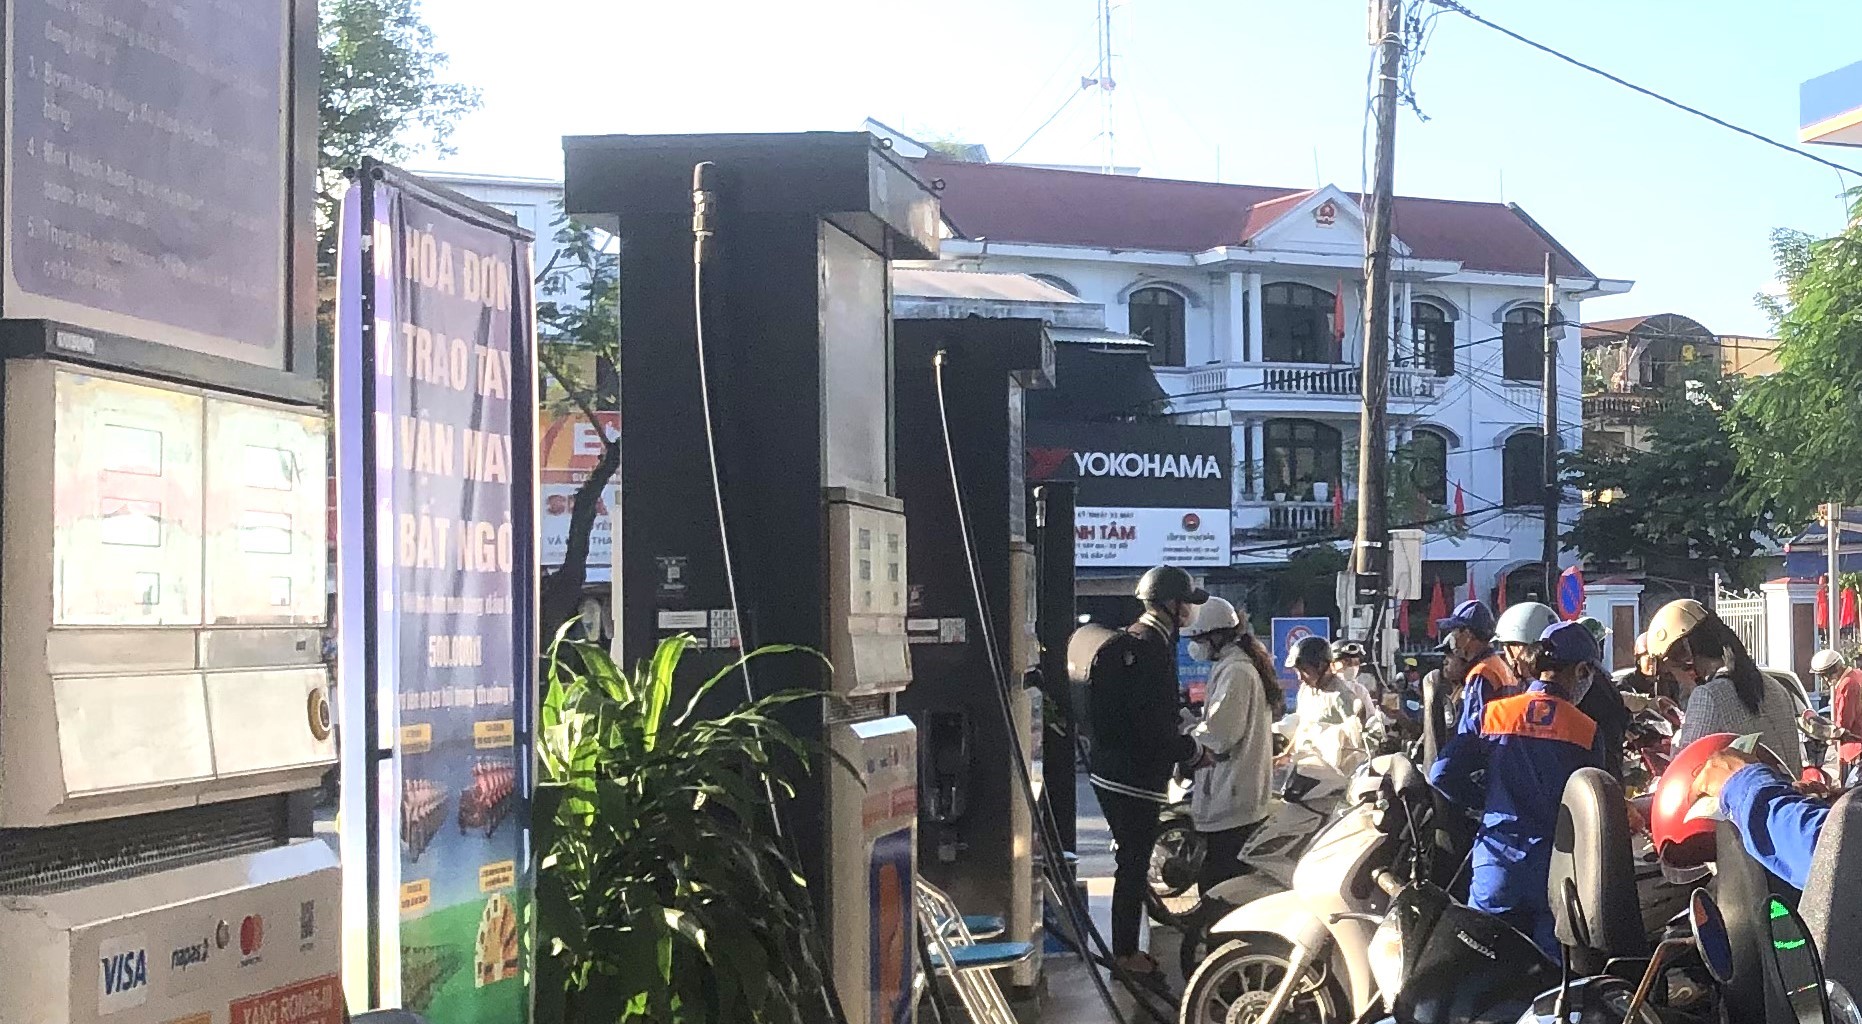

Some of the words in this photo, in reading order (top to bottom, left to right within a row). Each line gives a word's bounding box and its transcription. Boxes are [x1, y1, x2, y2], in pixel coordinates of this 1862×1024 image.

[405, 223, 455, 296] HÓA
[402, 322, 468, 391] TRAO
[1073, 452, 1222, 479] YOKOHAMA
[1100, 521, 1135, 540] TÂM
[101, 949, 147, 996] VISA
